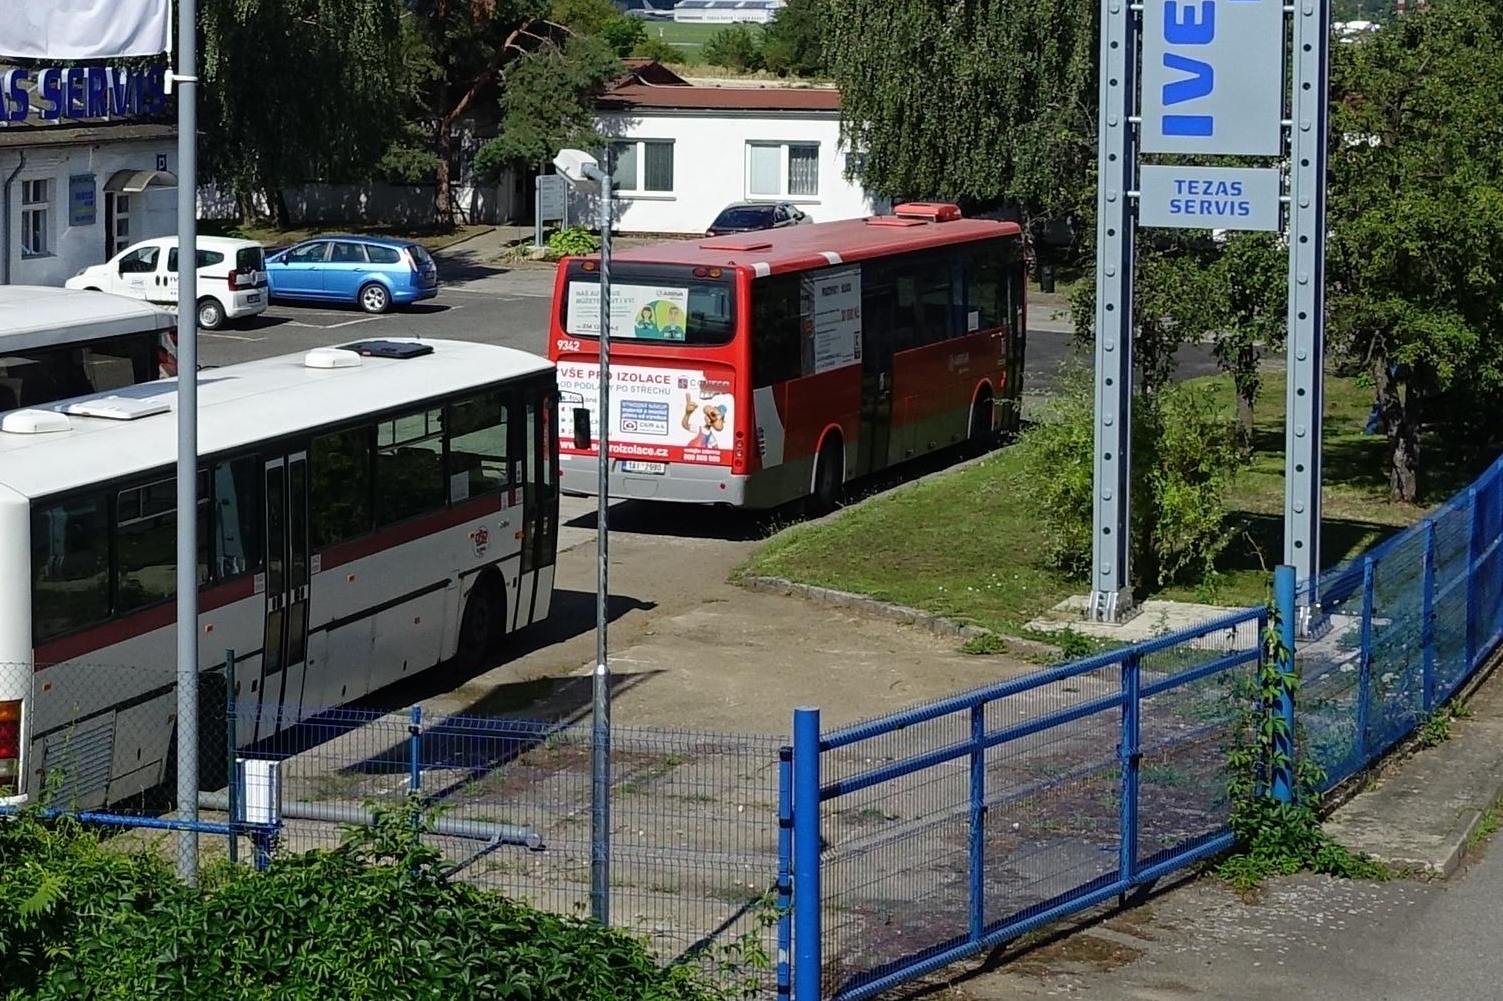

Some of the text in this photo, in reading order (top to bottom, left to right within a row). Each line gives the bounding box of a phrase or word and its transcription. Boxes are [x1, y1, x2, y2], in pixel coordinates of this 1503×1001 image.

[38, 63, 165, 120] SERVIS
[1173, 179, 1243, 197] TEZAS
[1169, 198, 1250, 217] SERVIS
[557, 340, 580, 351] 9342
[561, 367, 584, 379] VŠE
[617, 372, 671, 385] IZOLACE
